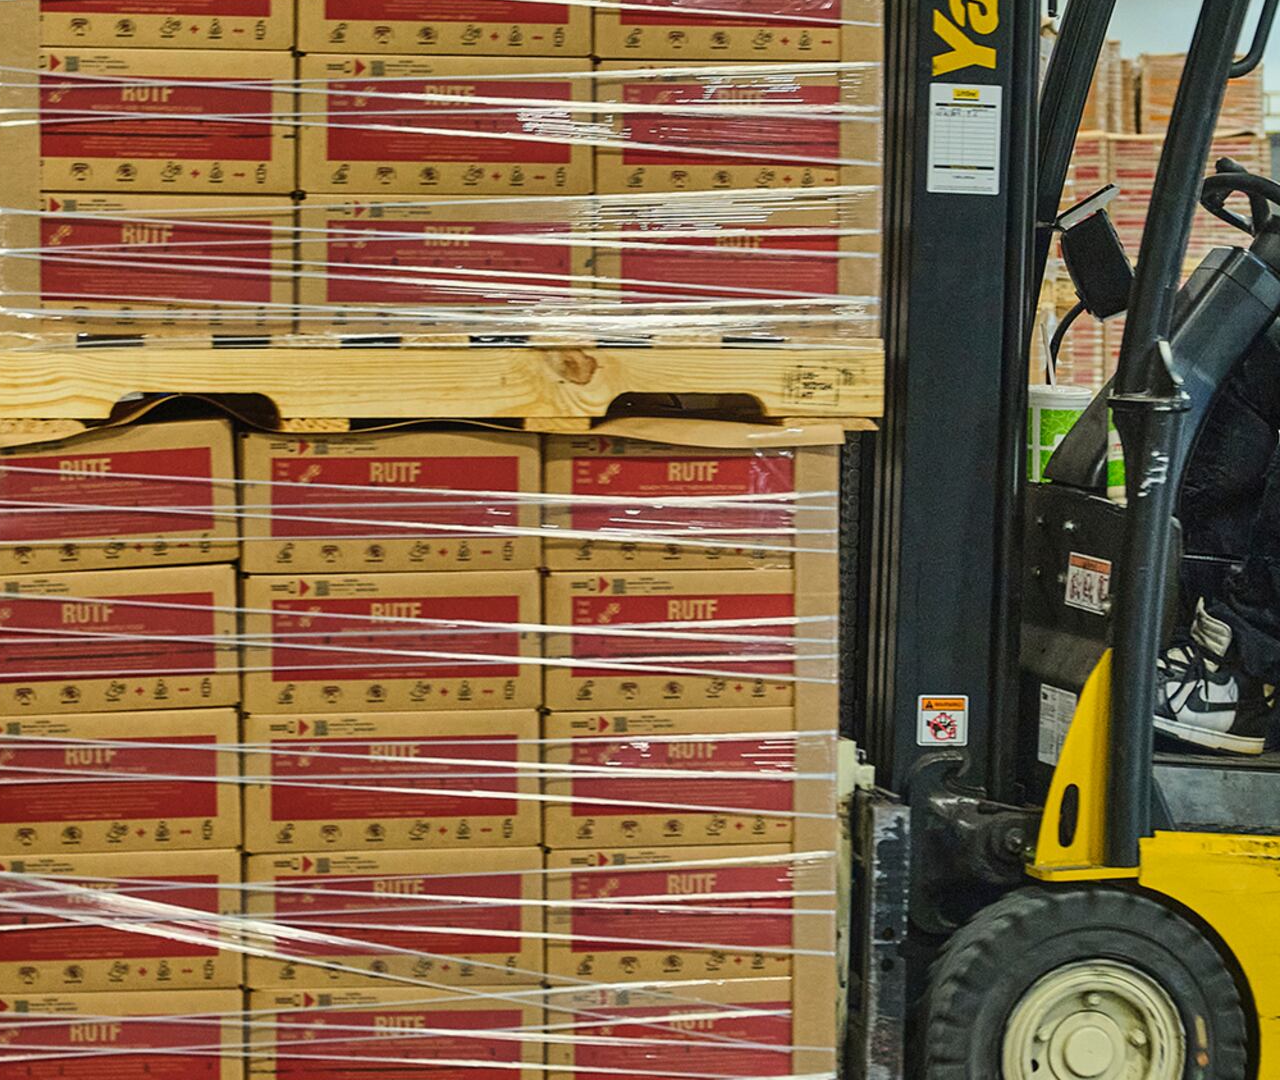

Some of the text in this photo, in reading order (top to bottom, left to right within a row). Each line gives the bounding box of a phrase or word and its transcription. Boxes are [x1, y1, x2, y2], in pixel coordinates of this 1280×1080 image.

[122, 82, 174, 102] RUTF
[122, 224, 174, 245] RUTF
[58, 458, 111, 481] RUTF
[370, 462, 421, 483] RUTF
[668, 461, 719, 482] RUTF
[61, 603, 114, 624] RUTF
[667, 599, 718, 620] RUTF
[64, 745, 116, 766] RUTF
[668, 740, 718, 759] RUTF
[667, 874, 717, 895] RUTF
[69, 1022, 122, 1042] RUTF
